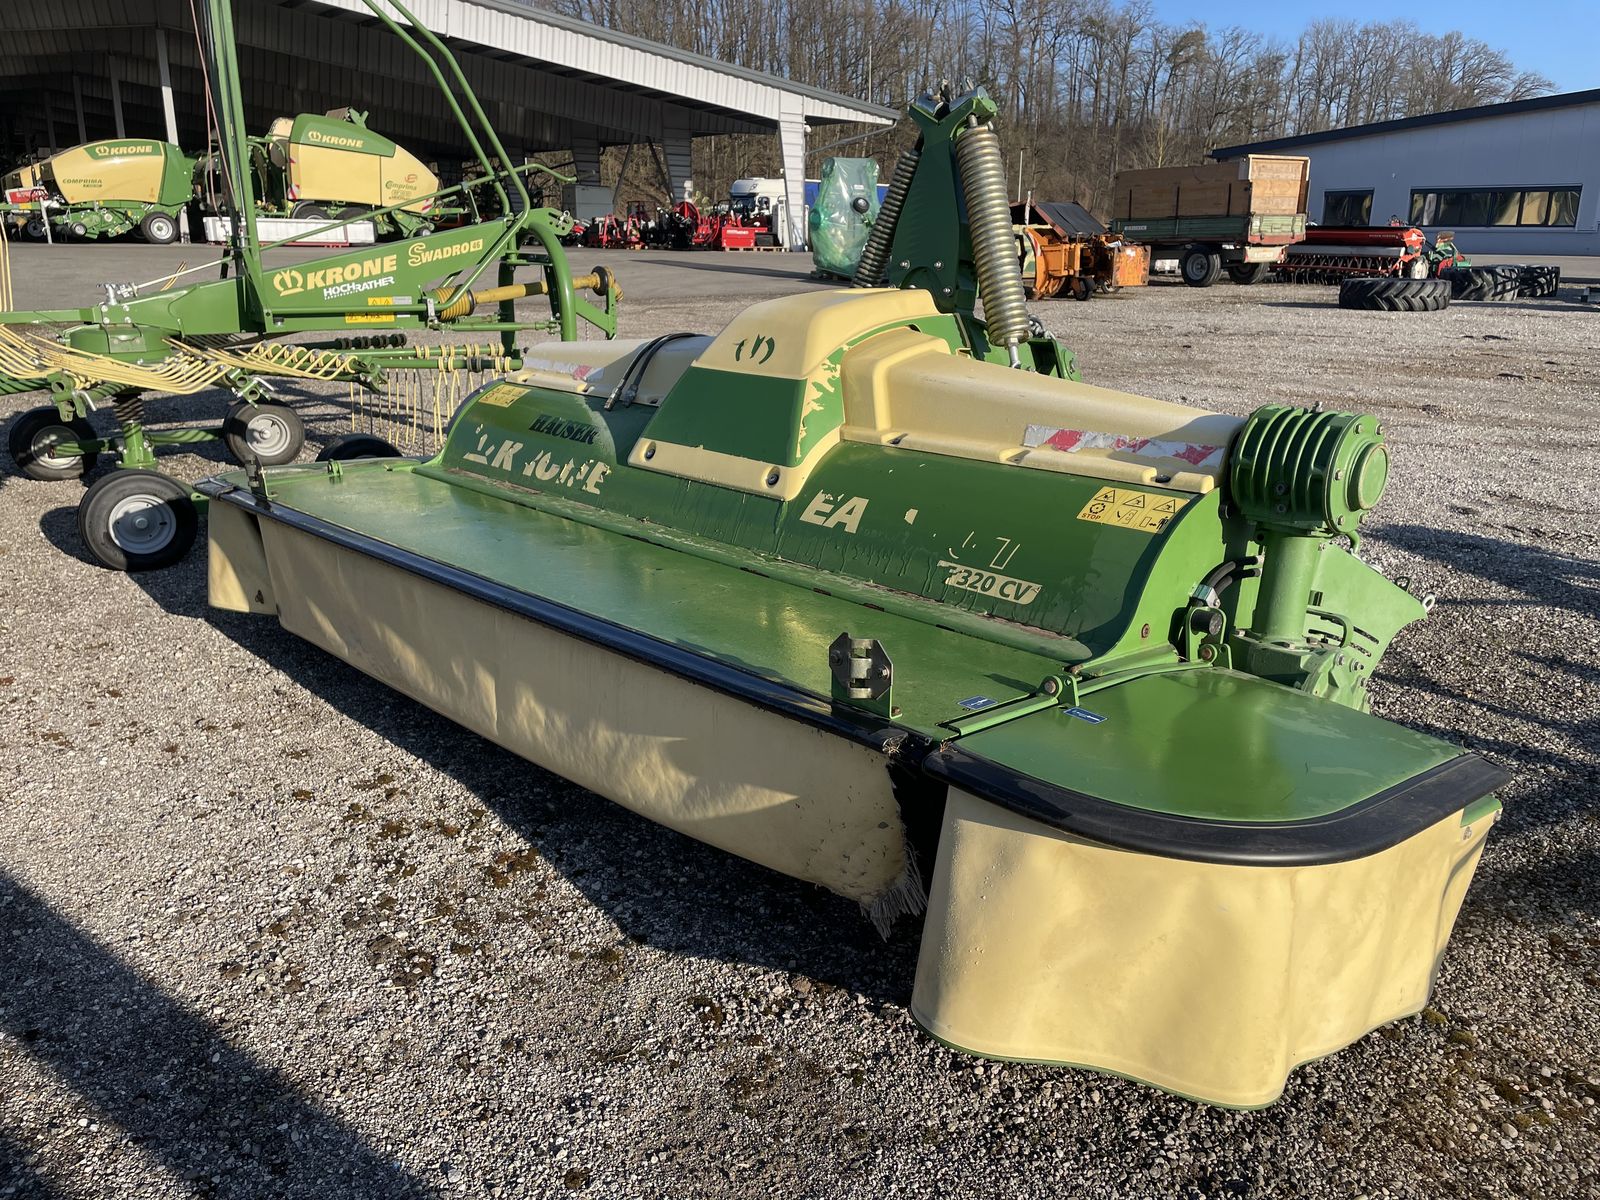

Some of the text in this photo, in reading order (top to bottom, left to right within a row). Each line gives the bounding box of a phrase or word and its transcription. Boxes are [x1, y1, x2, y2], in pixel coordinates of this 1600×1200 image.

[110, 145, 153, 155] KRONE
[321, 135, 364, 148] KRONE
[306, 254, 397, 290] KRONE
[323, 276, 396, 297] HOCHRATHER
[528, 413, 601, 445] HAUSER
[1082, 512, 1101, 520] STOP
[998, 580, 1034, 601] CV
